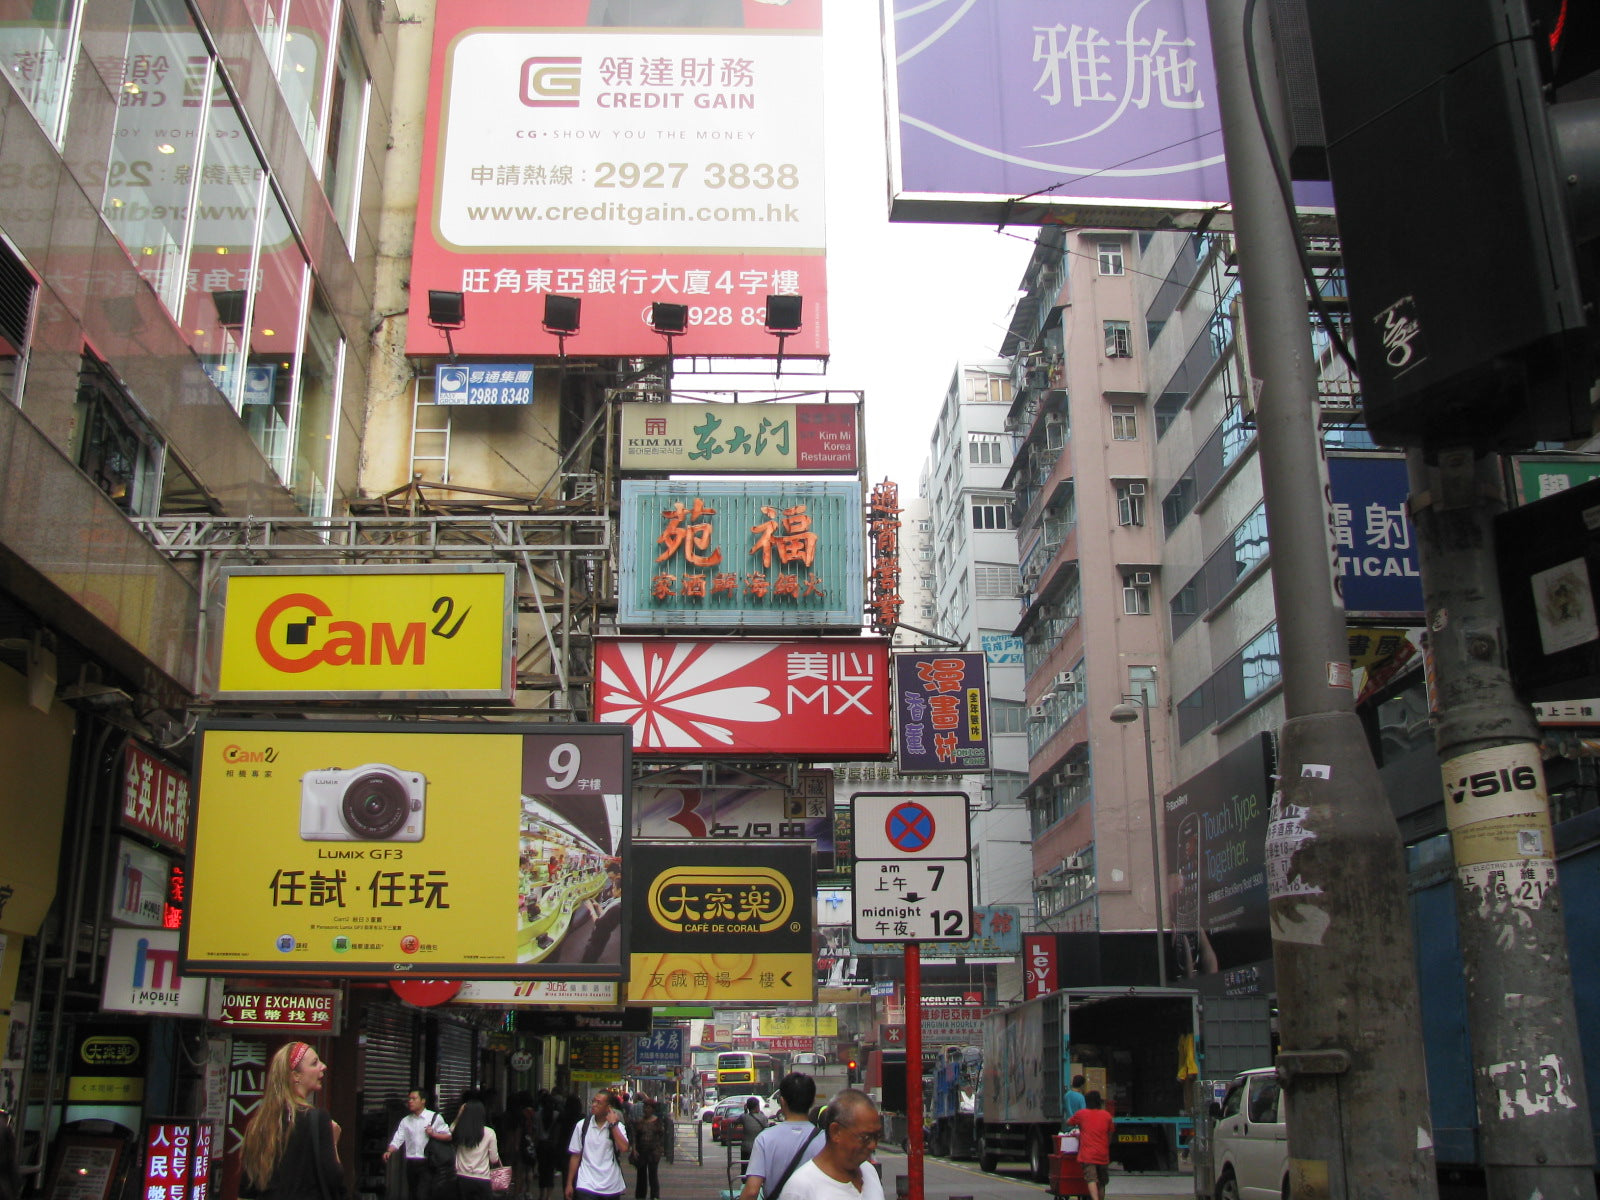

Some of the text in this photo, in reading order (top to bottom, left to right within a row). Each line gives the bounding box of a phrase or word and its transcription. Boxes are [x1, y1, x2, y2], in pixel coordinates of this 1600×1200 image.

[599, 57, 755, 88] 領達財務
[1032, 23, 1205, 109] 雅施
[596, 92, 755, 109] CREDIT GAIN
[613, 130, 647, 140] YOU
[656, 130, 686, 140] THE
[696, 130, 756, 140] MONEY
[594, 162, 689, 189] 2927
[704, 162, 800, 190] 3838
[467, 203, 800, 226] www.creditgain.com.hk
[461, 267, 800, 296] 旺角東亞銀行大廈4字樓
[470, 388, 530, 405] 2988 8348
[628, 438, 684, 446] KIM MI
[819, 432, 851, 440] Kim Mi
[824, 442, 851, 450] Korea
[801, 451, 852, 461] Restaurant
[1337, 556, 1420, 577] TICAL
[787, 651, 873, 682] 美心
[787, 685, 873, 716] MX
[546, 742, 581, 790] 9
[963, 756, 986, 766] ZONE
[226, 769, 273, 779] 相機專家
[125, 752, 190, 843] 金英人民幣
[318, 849, 404, 860] LUMIX GF3
[1205, 840, 1249, 882] Together.
[873, 876, 909, 893] 上午
[880, 864, 946, 892] am 7
[712, 923, 725, 933] DE
[727, 923, 760, 933] CORAL
[862, 905, 963, 936] midnight 12
[875, 920, 909, 937] 午夜
[649, 971, 776, 989] 友誠商場一樓
[139, 991, 180, 1002] MOBILE
[265, 996, 332, 1010] EXCHANGE
[920, 995, 962, 1007] KSILVER
[172, 1126, 190, 1179] MONEY
